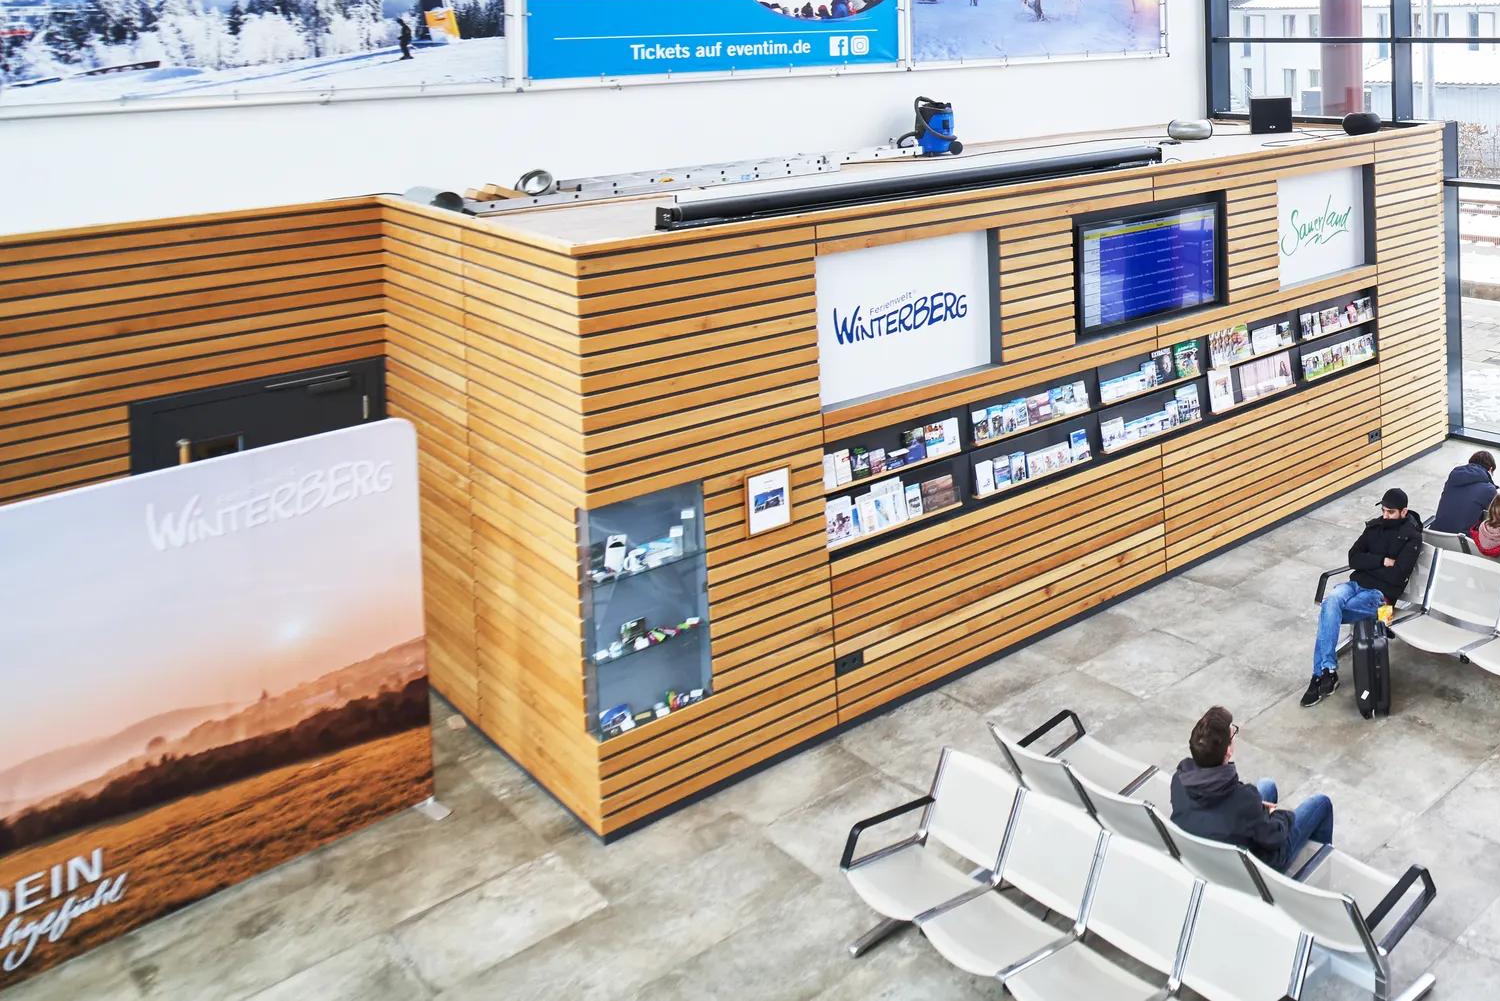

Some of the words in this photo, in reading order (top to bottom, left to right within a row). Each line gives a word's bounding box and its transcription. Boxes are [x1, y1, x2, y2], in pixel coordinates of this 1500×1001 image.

[630, 42, 691, 60] Tickets
[695, 41, 722, 58] auf
[726, 39, 812, 57] eventim.de
[1281, 193, 1351, 256] Sauerland
[869, 291, 913, 316] Ferienwelt
